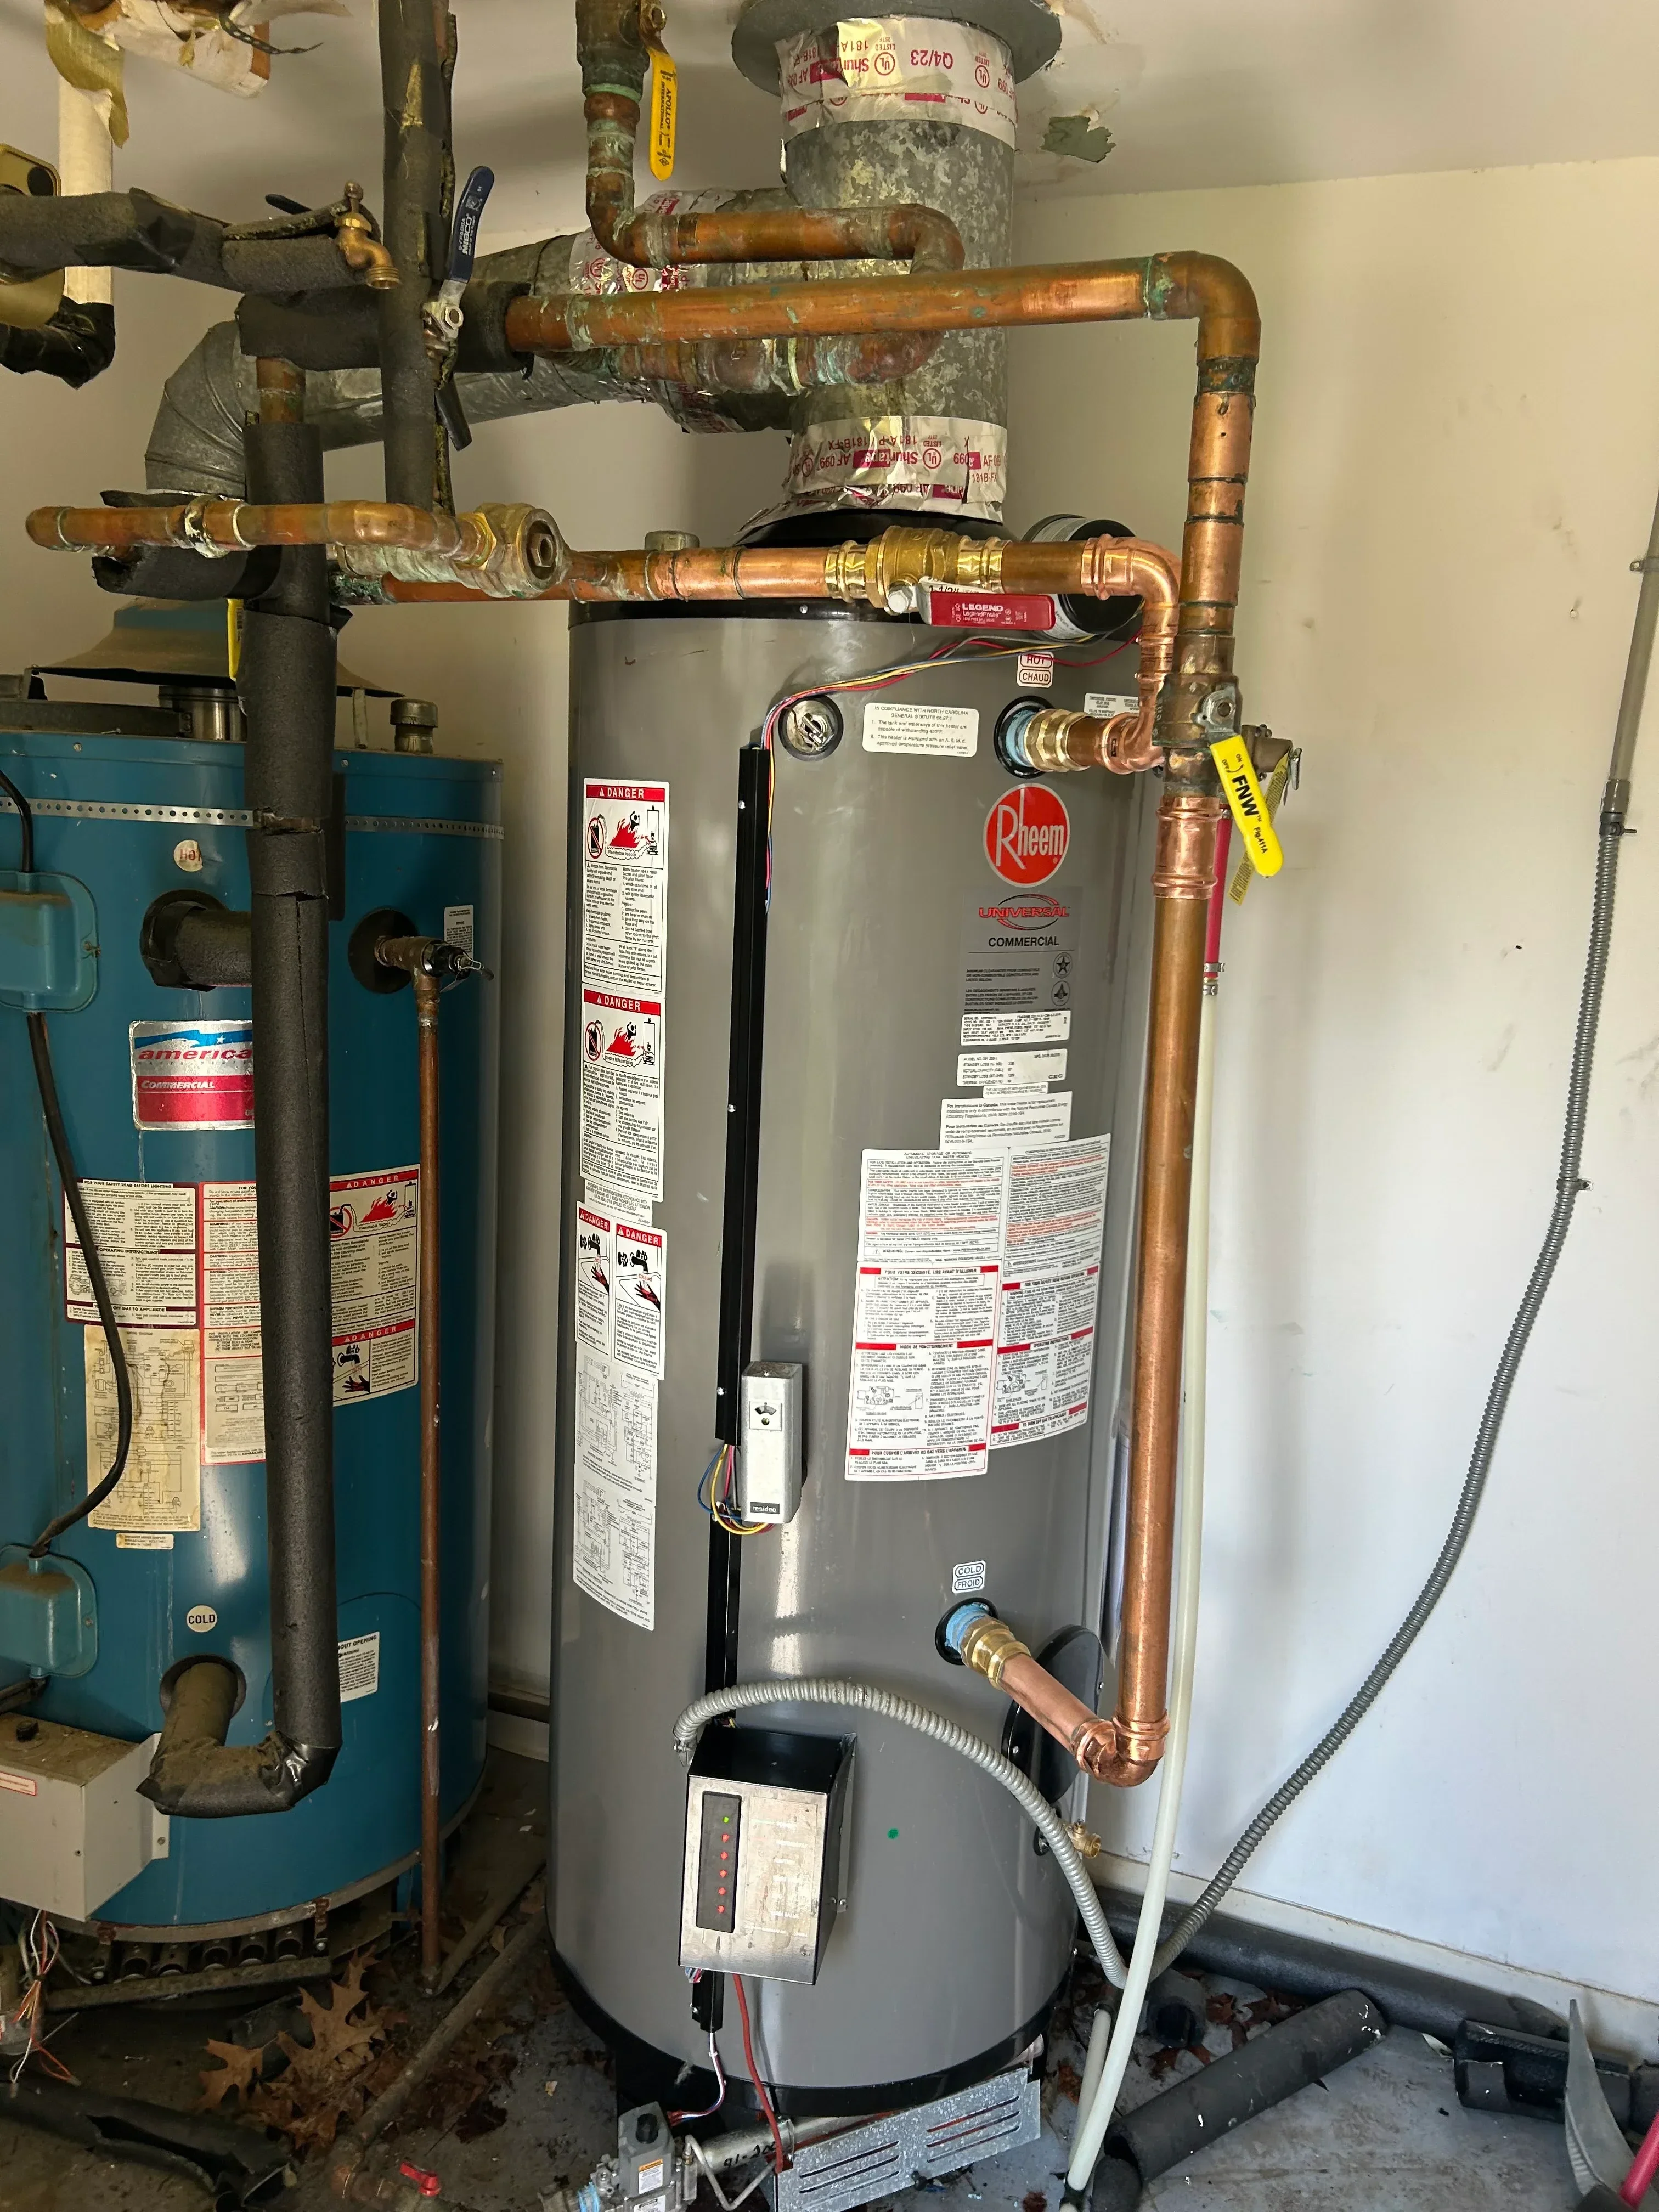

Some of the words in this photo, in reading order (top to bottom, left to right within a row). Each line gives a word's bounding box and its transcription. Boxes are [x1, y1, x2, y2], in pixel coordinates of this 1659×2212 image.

[911, 49, 953, 69] Q4/23
[461, 216, 472, 255] NIBCO
[962, 603, 1003, 612] LEGEND
[1026, 656, 1046, 665] HOT
[1022, 673, 1049, 682] CHAUD
[1235, 753, 1243, 762] ON
[1222, 759, 1230, 770] OFF
[607, 787, 644, 799] DANGER
[995, 788, 1064, 870] Rheem
[1254, 827, 1268, 854] Fig.411A
[979, 907, 1069, 918] UNIVERSAL
[988, 936, 1059, 947] COMMERCIAL
[605, 996, 641, 1011] DANGER
[138, 1049, 252, 1060] america
[141, 1080, 215, 1090] COMMERCIAL
[354, 1175, 398, 1187] DANGER
[585, 1213, 608, 1229] DANGER
[625, 1229, 659, 1245] DANGER
[352, 1325, 397, 1340] DANGER
[958, 1565, 981, 1575] COLD
[957, 1579, 980, 1588] FROID
[188, 1614, 215, 1624] COLD
[353, 1634, 377, 1646] OPENING
